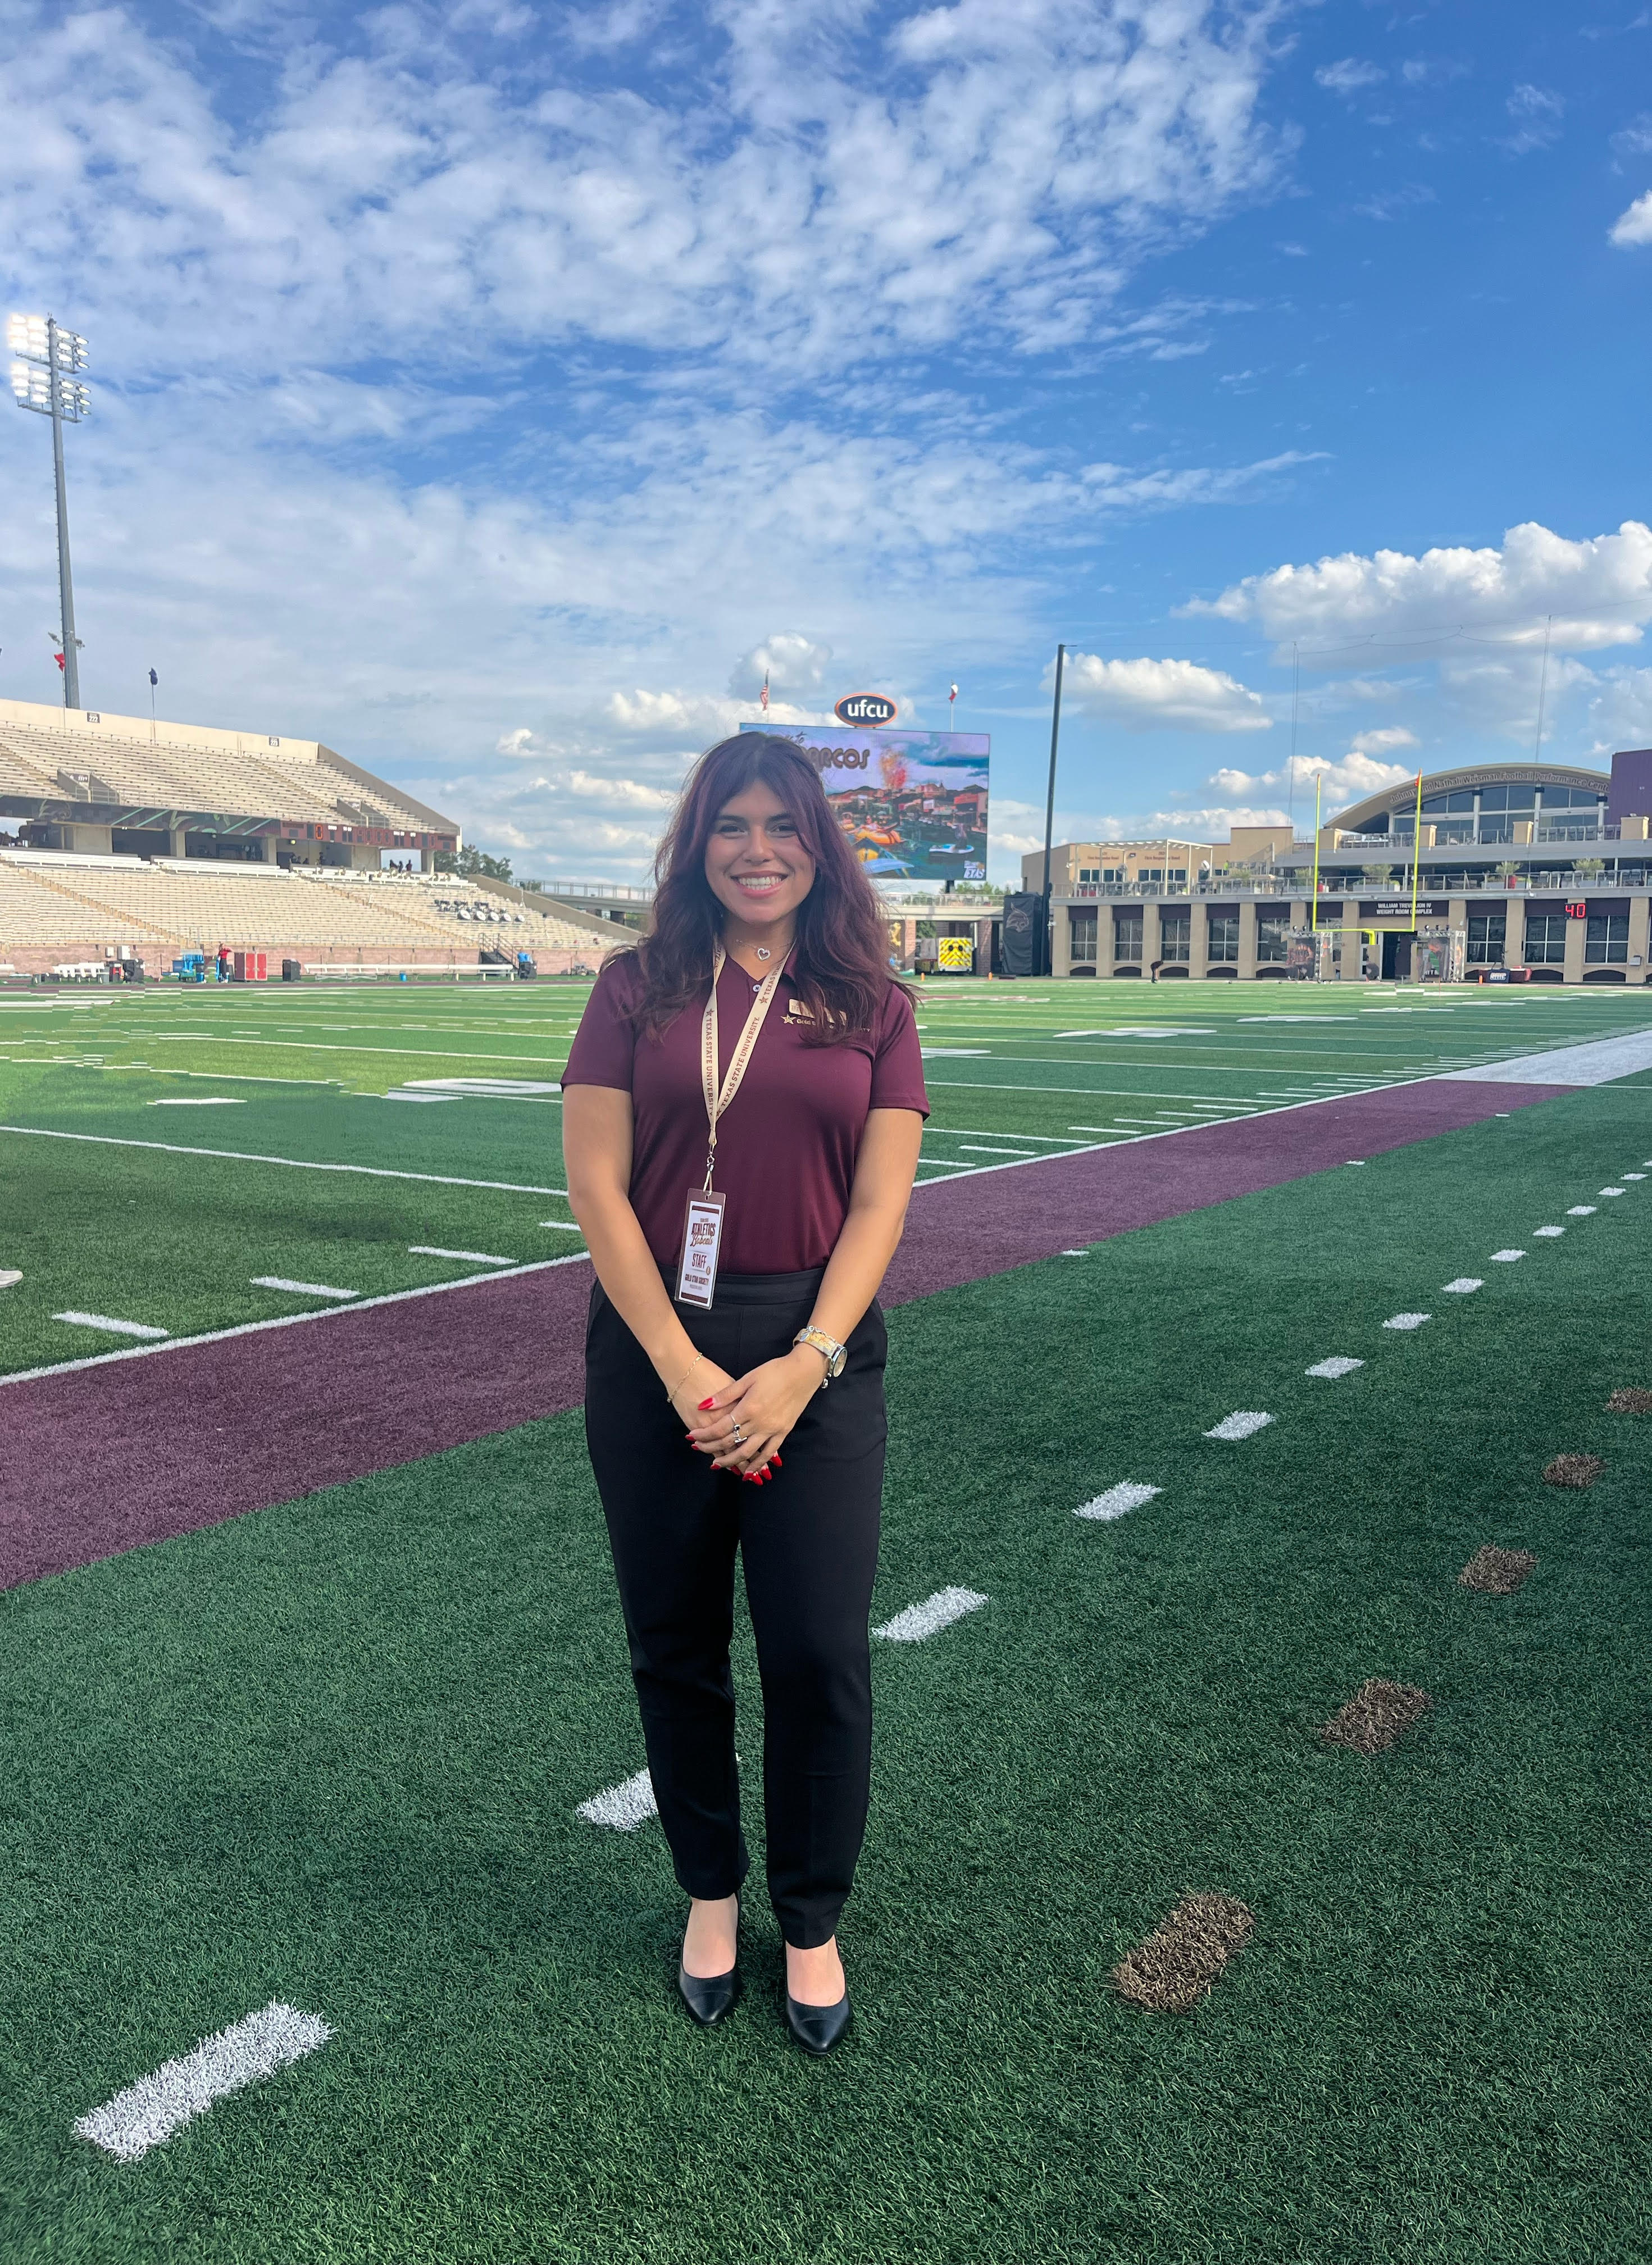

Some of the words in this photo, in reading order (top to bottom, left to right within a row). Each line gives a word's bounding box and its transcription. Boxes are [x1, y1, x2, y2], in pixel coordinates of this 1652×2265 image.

[847, 699, 888, 718] ufcu
[806, 747, 870, 770] ARCOS
[1390, 789, 1417, 804] Johnny
[1461, 772, 1500, 784] Weisman
[1500, 771, 1534, 781] Football
[1535, 771, 1587, 787] Performance
[1565, 904, 1586, 918] 40
[764, 976, 776, 995] TEXAS
[721, 1082, 735, 1107] TEXAS
[732, 1058, 745, 1081] STATE
[691, 1222, 716, 1236] ATHLETICS
[690, 1232, 713, 1247] Bobcats
[692, 1253, 707, 1269] STAFF
